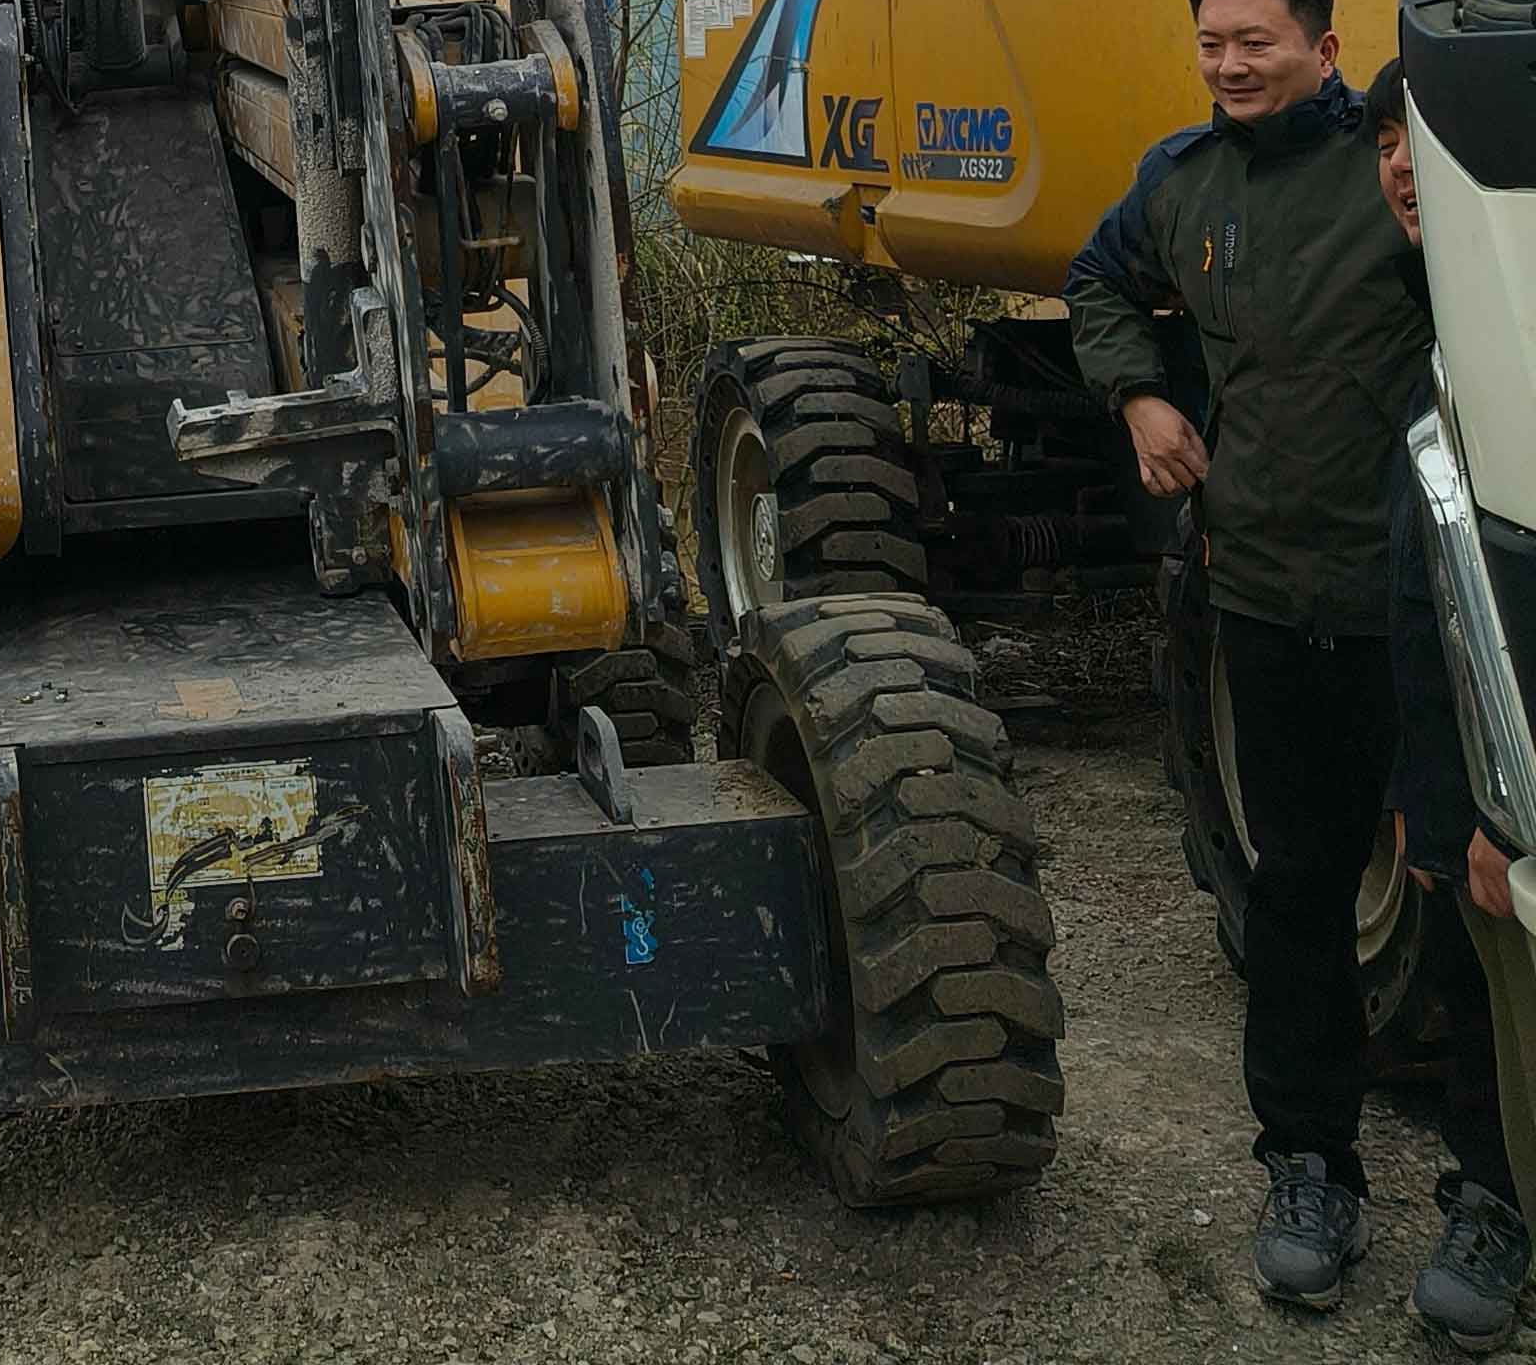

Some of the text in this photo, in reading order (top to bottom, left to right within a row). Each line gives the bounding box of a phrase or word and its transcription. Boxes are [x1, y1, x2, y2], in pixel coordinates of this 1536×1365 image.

[938, 107, 1012, 152] XCMG
[960, 158, 1003, 179] XGS22
[1224, 223, 1237, 269] OUTDOOR
